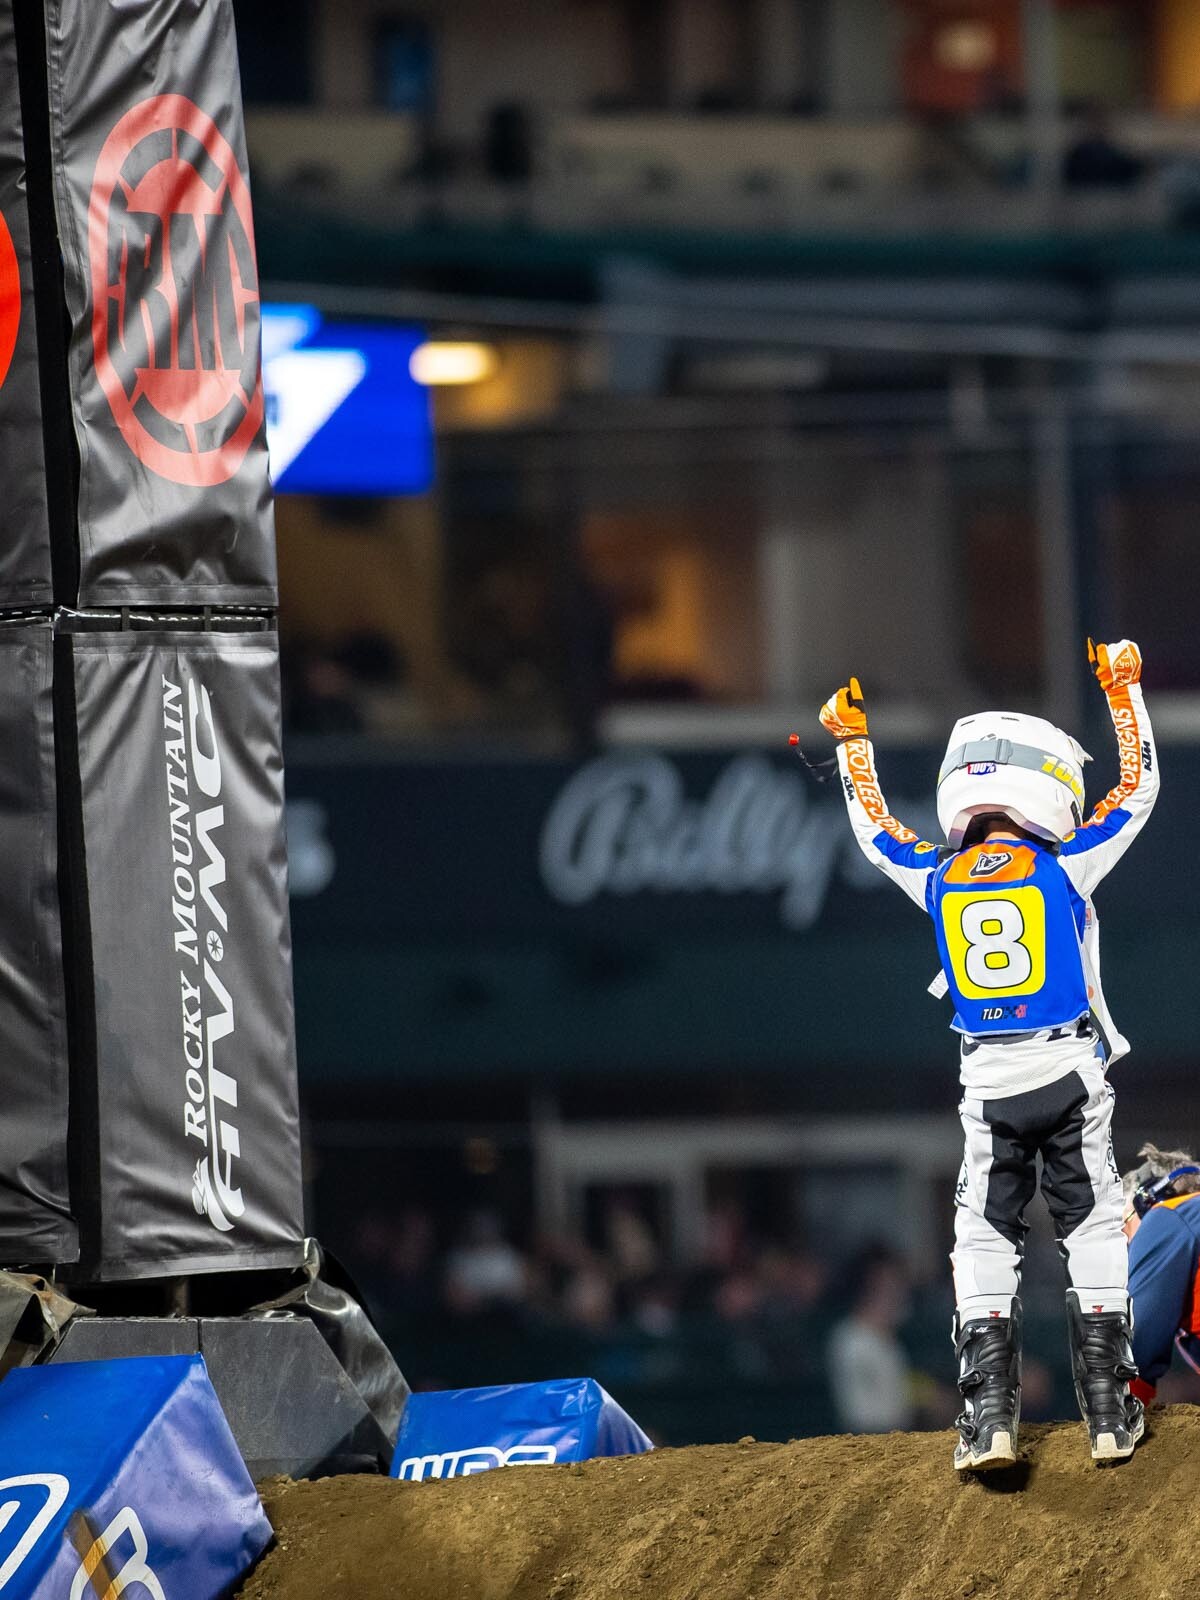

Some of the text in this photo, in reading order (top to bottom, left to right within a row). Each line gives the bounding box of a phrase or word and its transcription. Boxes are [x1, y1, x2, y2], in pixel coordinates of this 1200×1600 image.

[969, 762, 996, 775] 100%
[1112, 707, 1139, 786] DESIGNS
[1141, 740, 1152, 772] KTM
[161, 673, 208, 1148] ROCKY MOUNTAIN
[960, 899, 1033, 990] 8
[982, 1007, 1004, 1021] TLD
